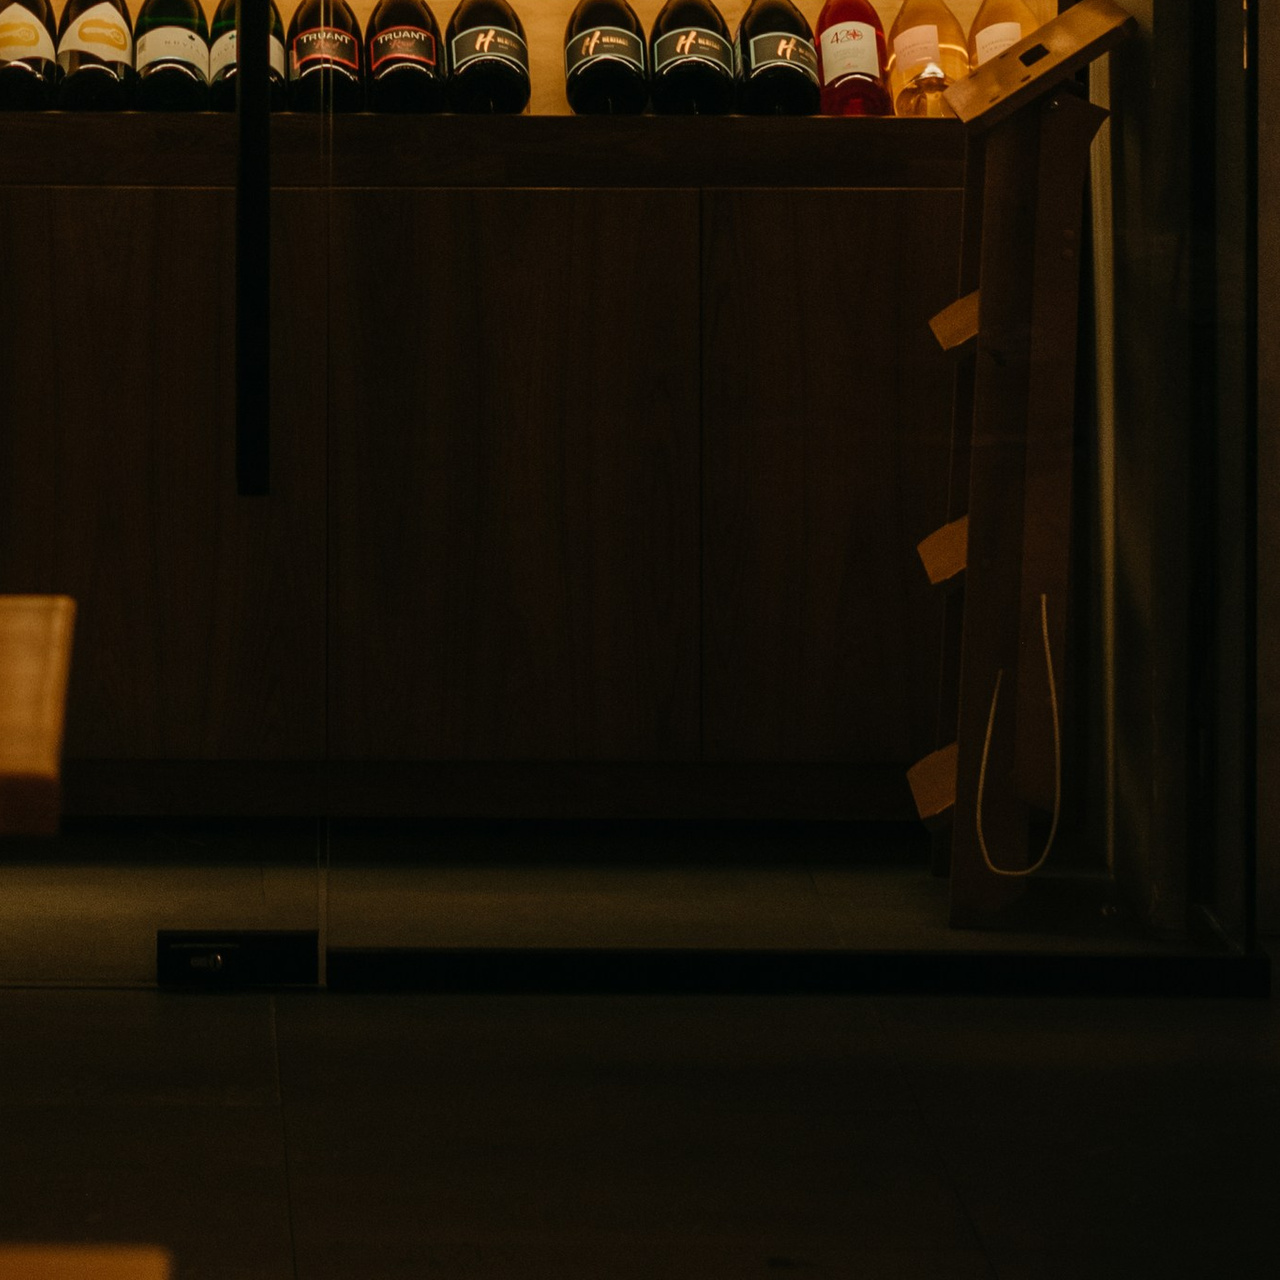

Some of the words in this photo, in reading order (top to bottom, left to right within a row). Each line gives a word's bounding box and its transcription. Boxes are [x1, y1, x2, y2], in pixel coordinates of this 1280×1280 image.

[300, 32, 351, 44] TRUANT
[377, 30, 427, 44] TRUANT
[475, 29, 496, 53] H
[581, 30, 601, 56] H
[676, 31, 697, 55] H
[776, 37, 797, 60] H
